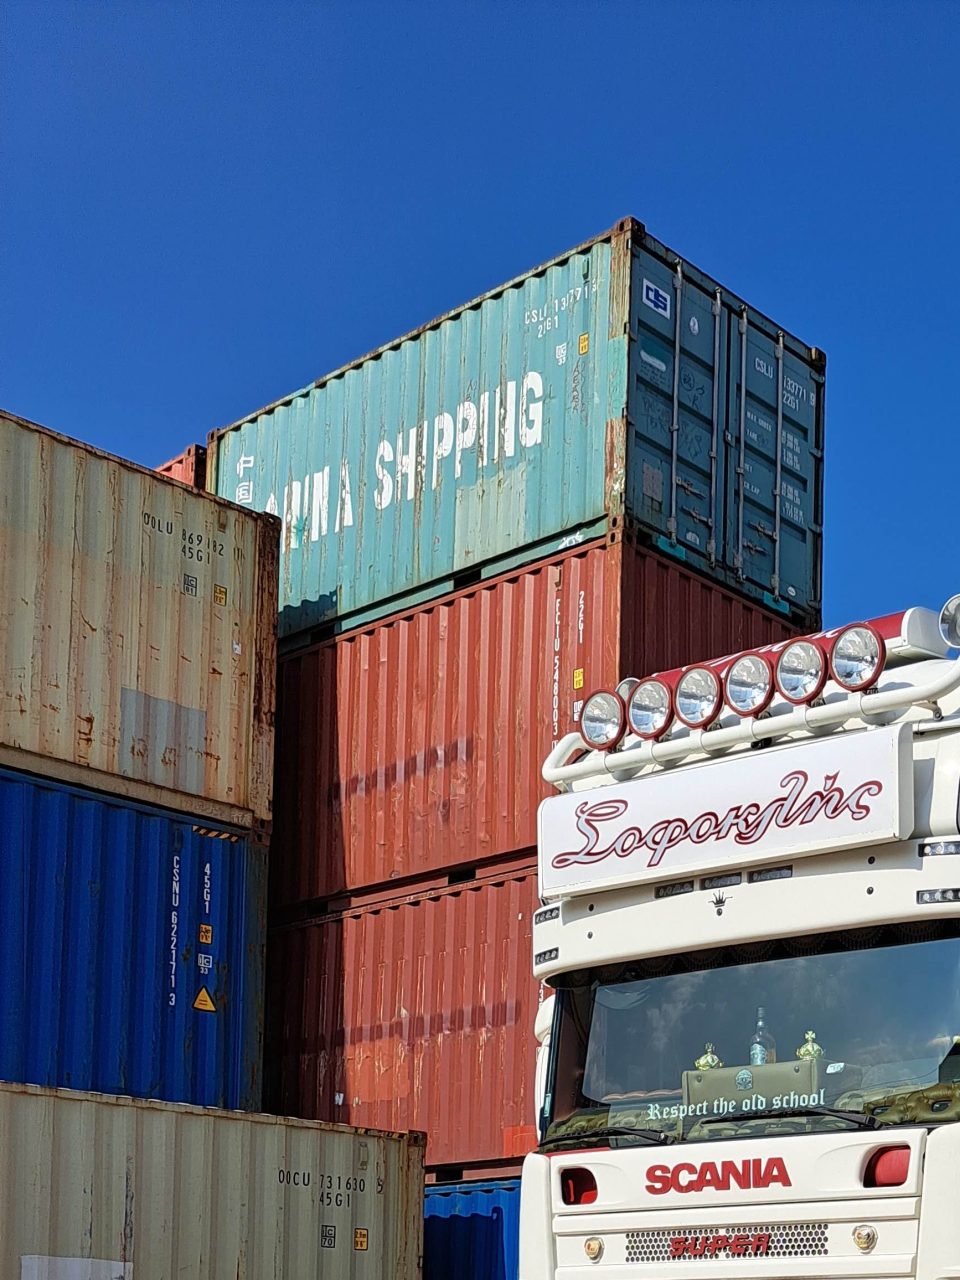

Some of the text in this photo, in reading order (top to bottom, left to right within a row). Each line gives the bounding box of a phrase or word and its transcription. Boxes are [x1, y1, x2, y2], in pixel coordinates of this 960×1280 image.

[755, 357, 773, 379] CSLU
[374, 371, 543, 510] SHIPPING
[264, 457, 354, 554] HINA
[181, 529, 224, 557] 869182
[181, 544, 210, 565] 45G1
[203, 863, 211, 914] 45G1
[168, 855, 180, 1006] CSNU 622171 3
[646, 1088, 826, 1121] Respect the old school
[320, 1174, 366, 1193] 731630
[645, 1157, 792, 1195] SCANIA
[320, 1192, 351, 1208] 45G1
[669, 1233, 770, 1257] SUPER
